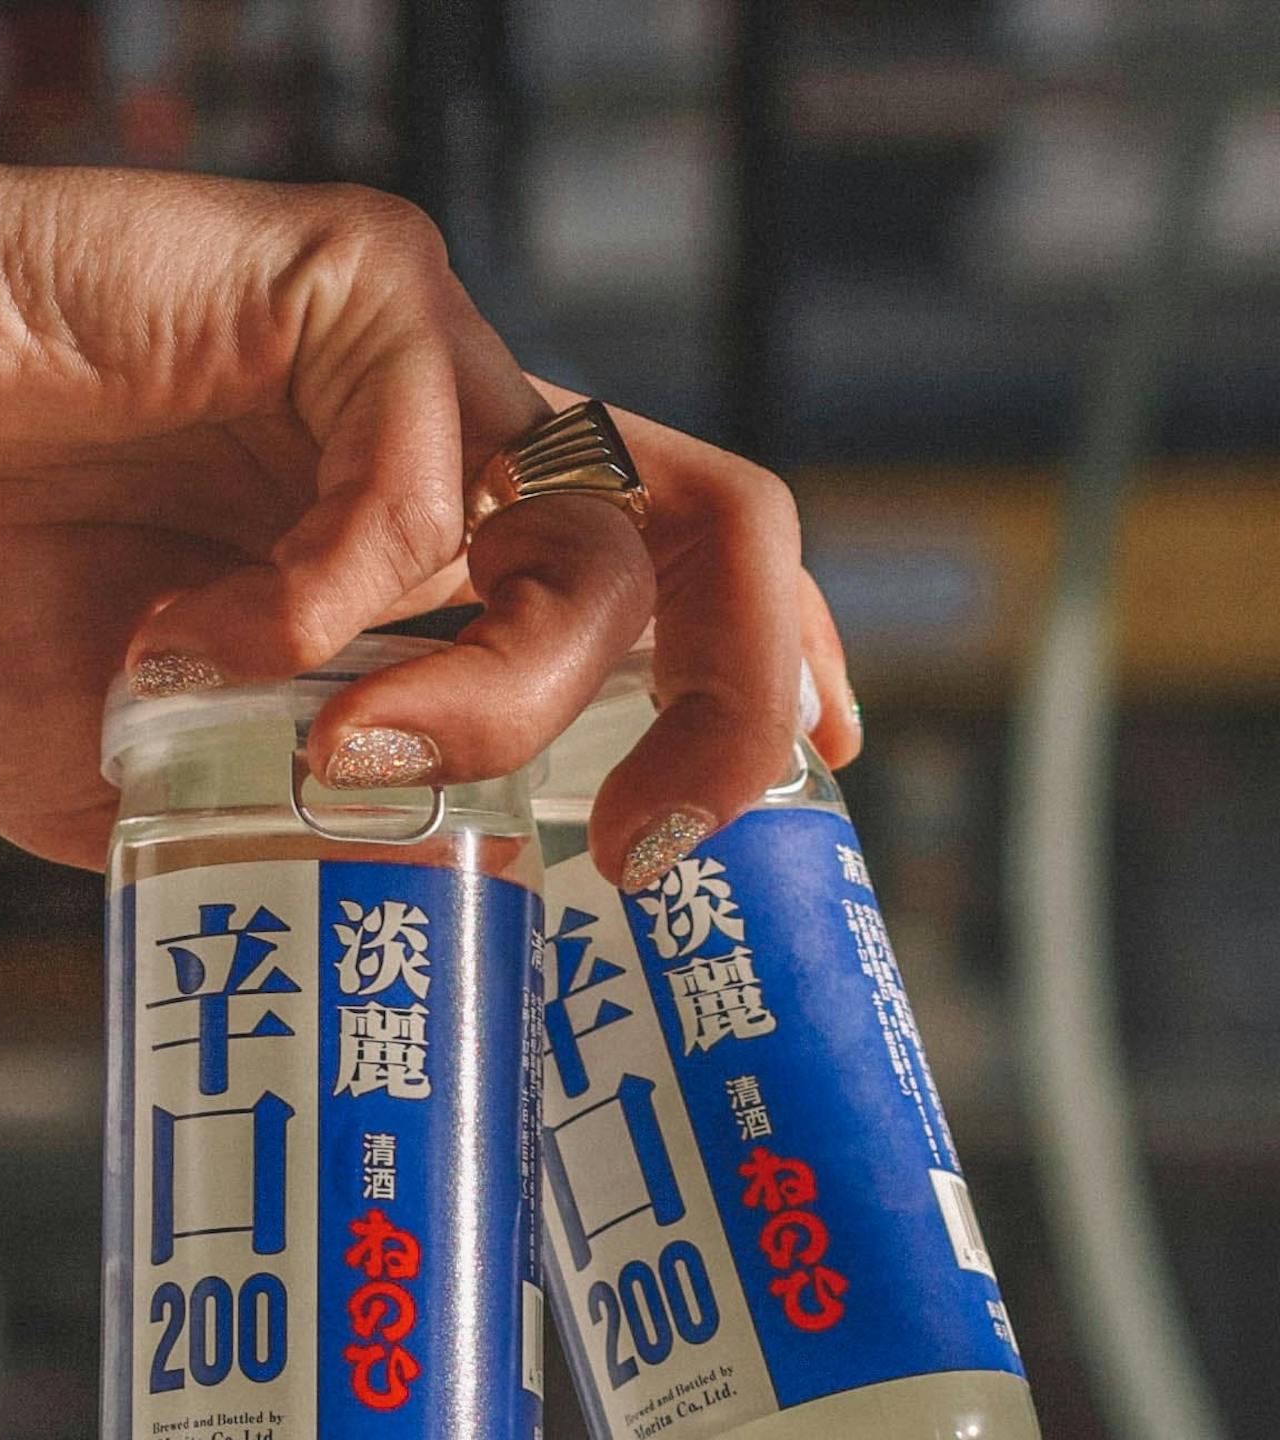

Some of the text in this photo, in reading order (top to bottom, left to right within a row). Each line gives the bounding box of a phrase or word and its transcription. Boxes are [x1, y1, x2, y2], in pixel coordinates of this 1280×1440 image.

[332, 898, 433, 1101] 淡麗
[631, 856, 778, 1058] 淡麗
[144, 903, 303, 1267] 辛口
[724, 1073, 773, 1142] 清酒
[362, 1132, 397, 1201] 清酒
[736, 1144, 849, 1334] ねのひ
[149, 1271, 288, 1395] 200
[342, 1207, 422, 1412] ねのひ
[588, 1238, 720, 1392] 200
[657, 1389, 675, 1407] and
[675, 1369, 718, 1397] Bottled
[719, 1364, 736, 1380] by
[153, 1410, 285, 1435] Brewed and Bottled by
